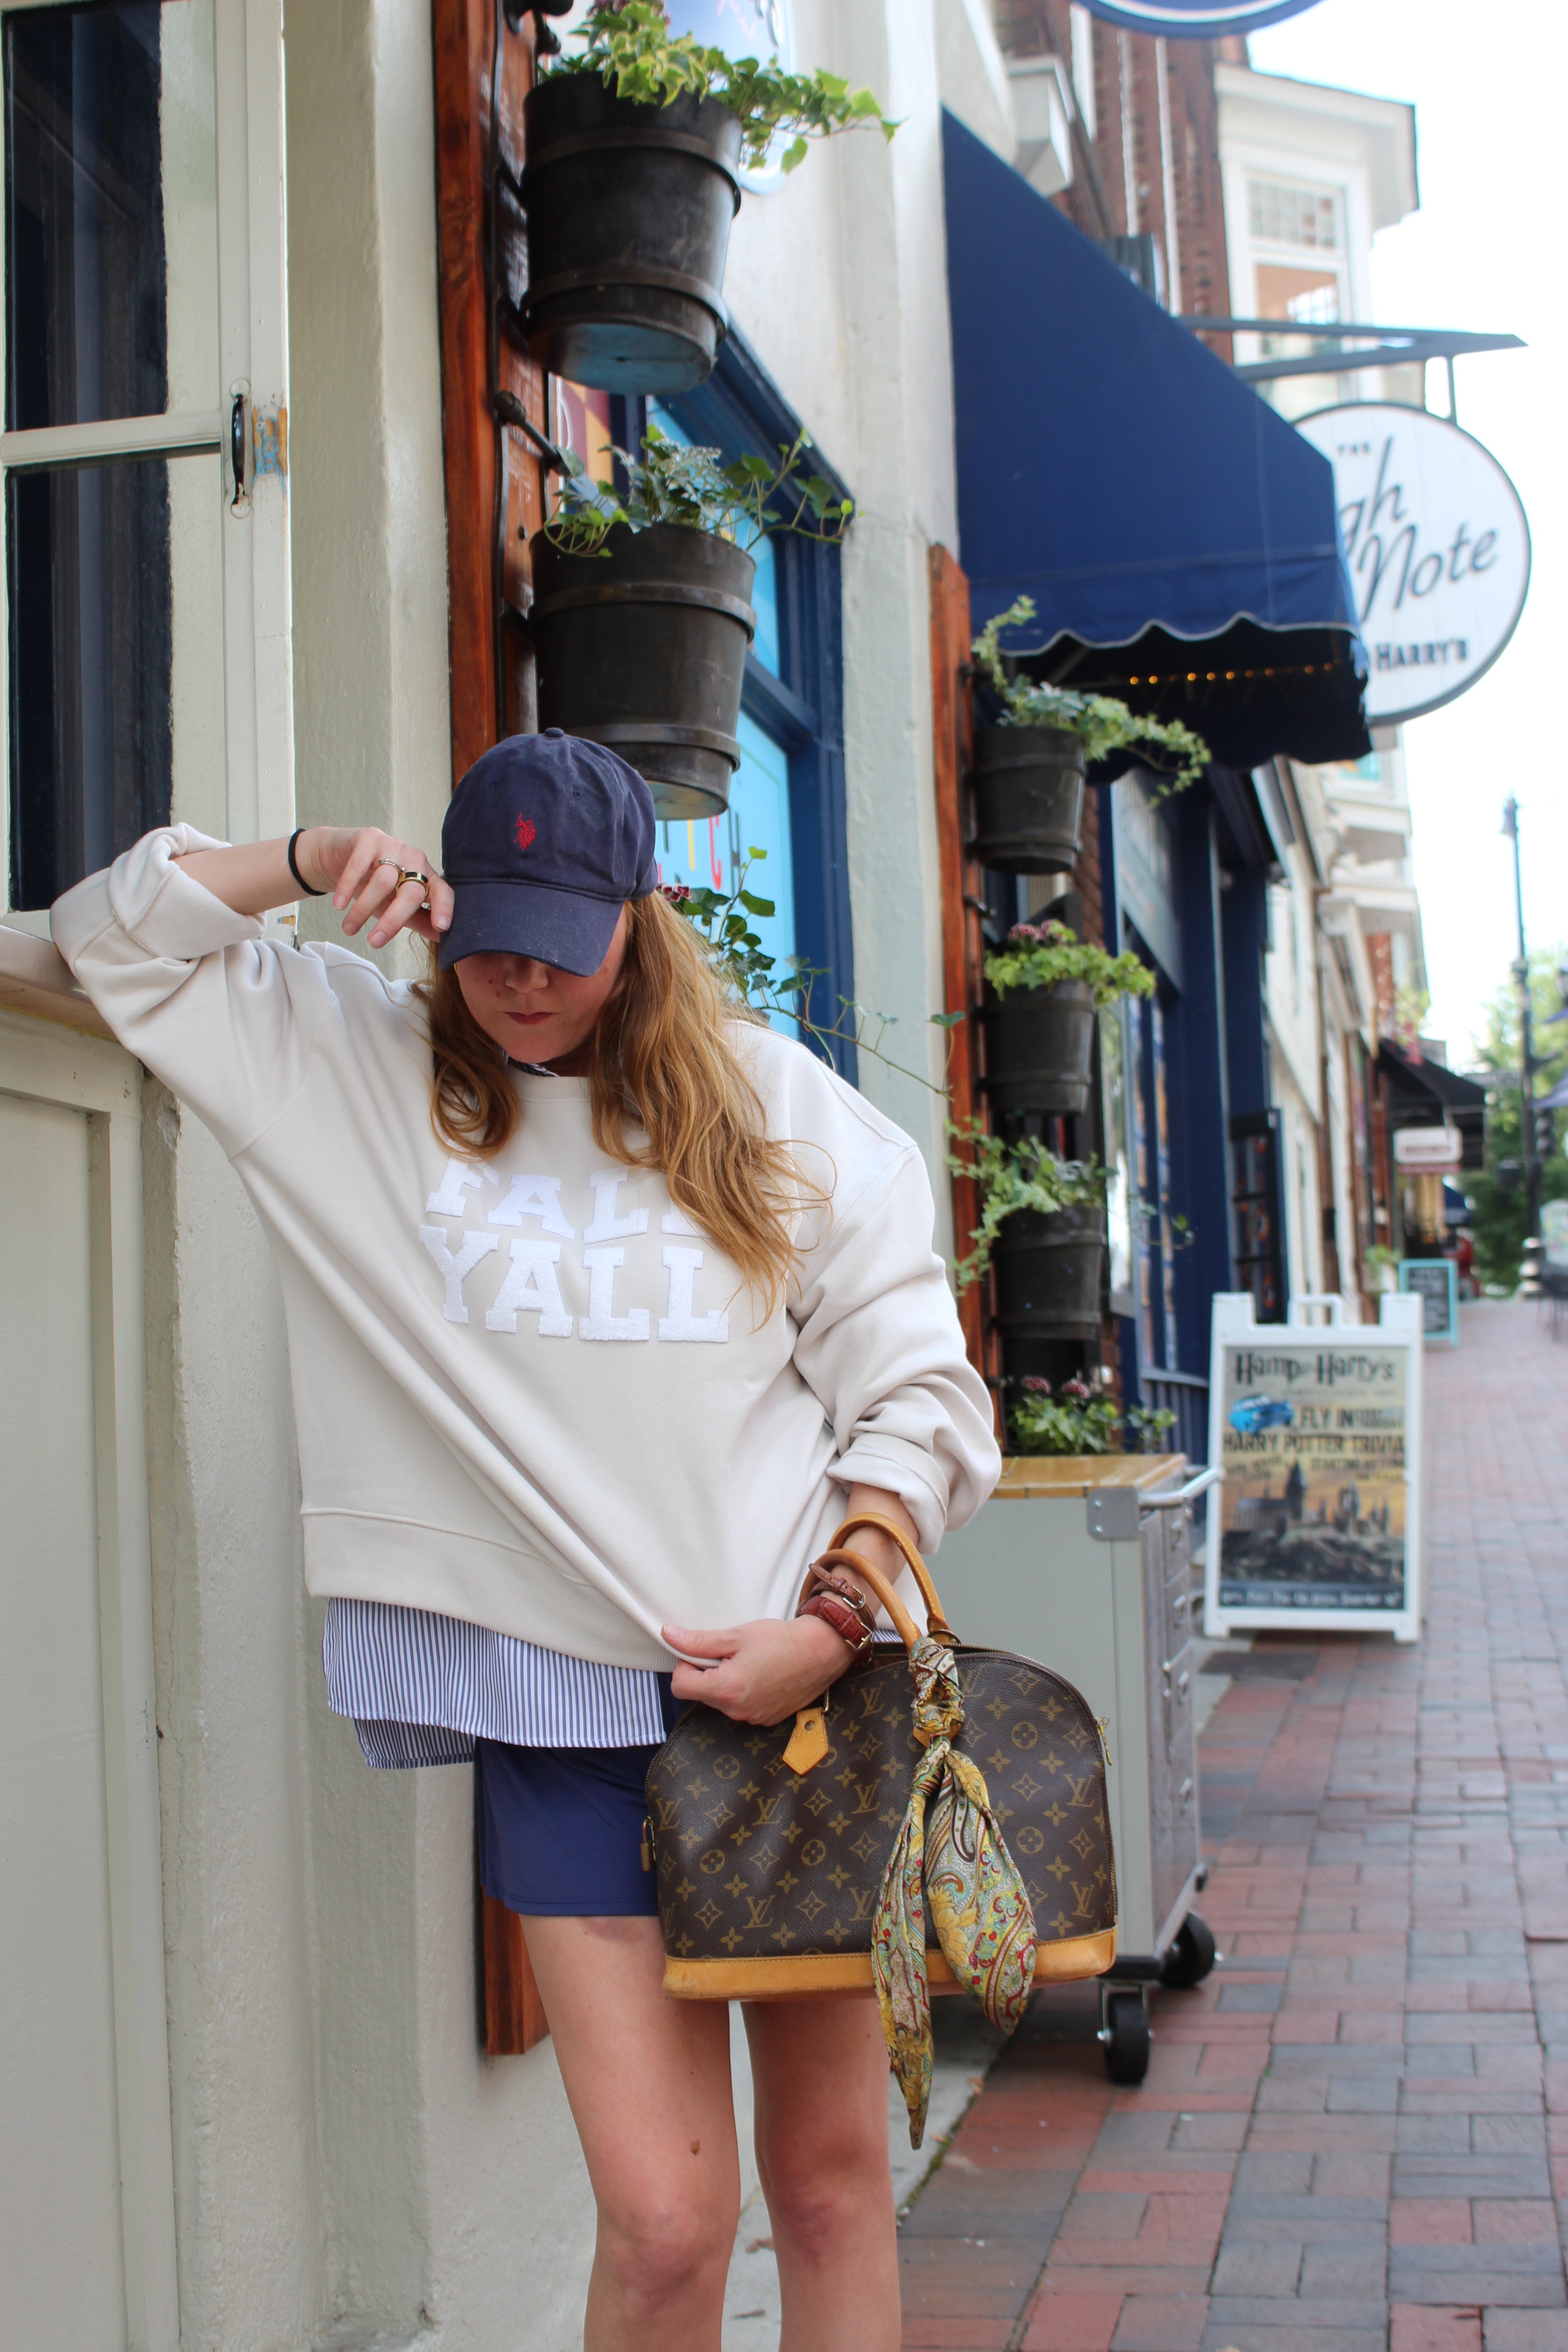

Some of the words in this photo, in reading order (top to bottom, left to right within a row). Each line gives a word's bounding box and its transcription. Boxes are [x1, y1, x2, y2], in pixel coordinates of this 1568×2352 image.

[1339, 436, 1407, 557] gh
[1356, 521, 1497, 624] Note
[418, 1225, 729, 1343] YALL
[1284, 1435, 1343, 1452] POTTER
[1352, 1435, 1405, 1453] TRIVIA
[1299, 1407, 1329, 1428] FLY
